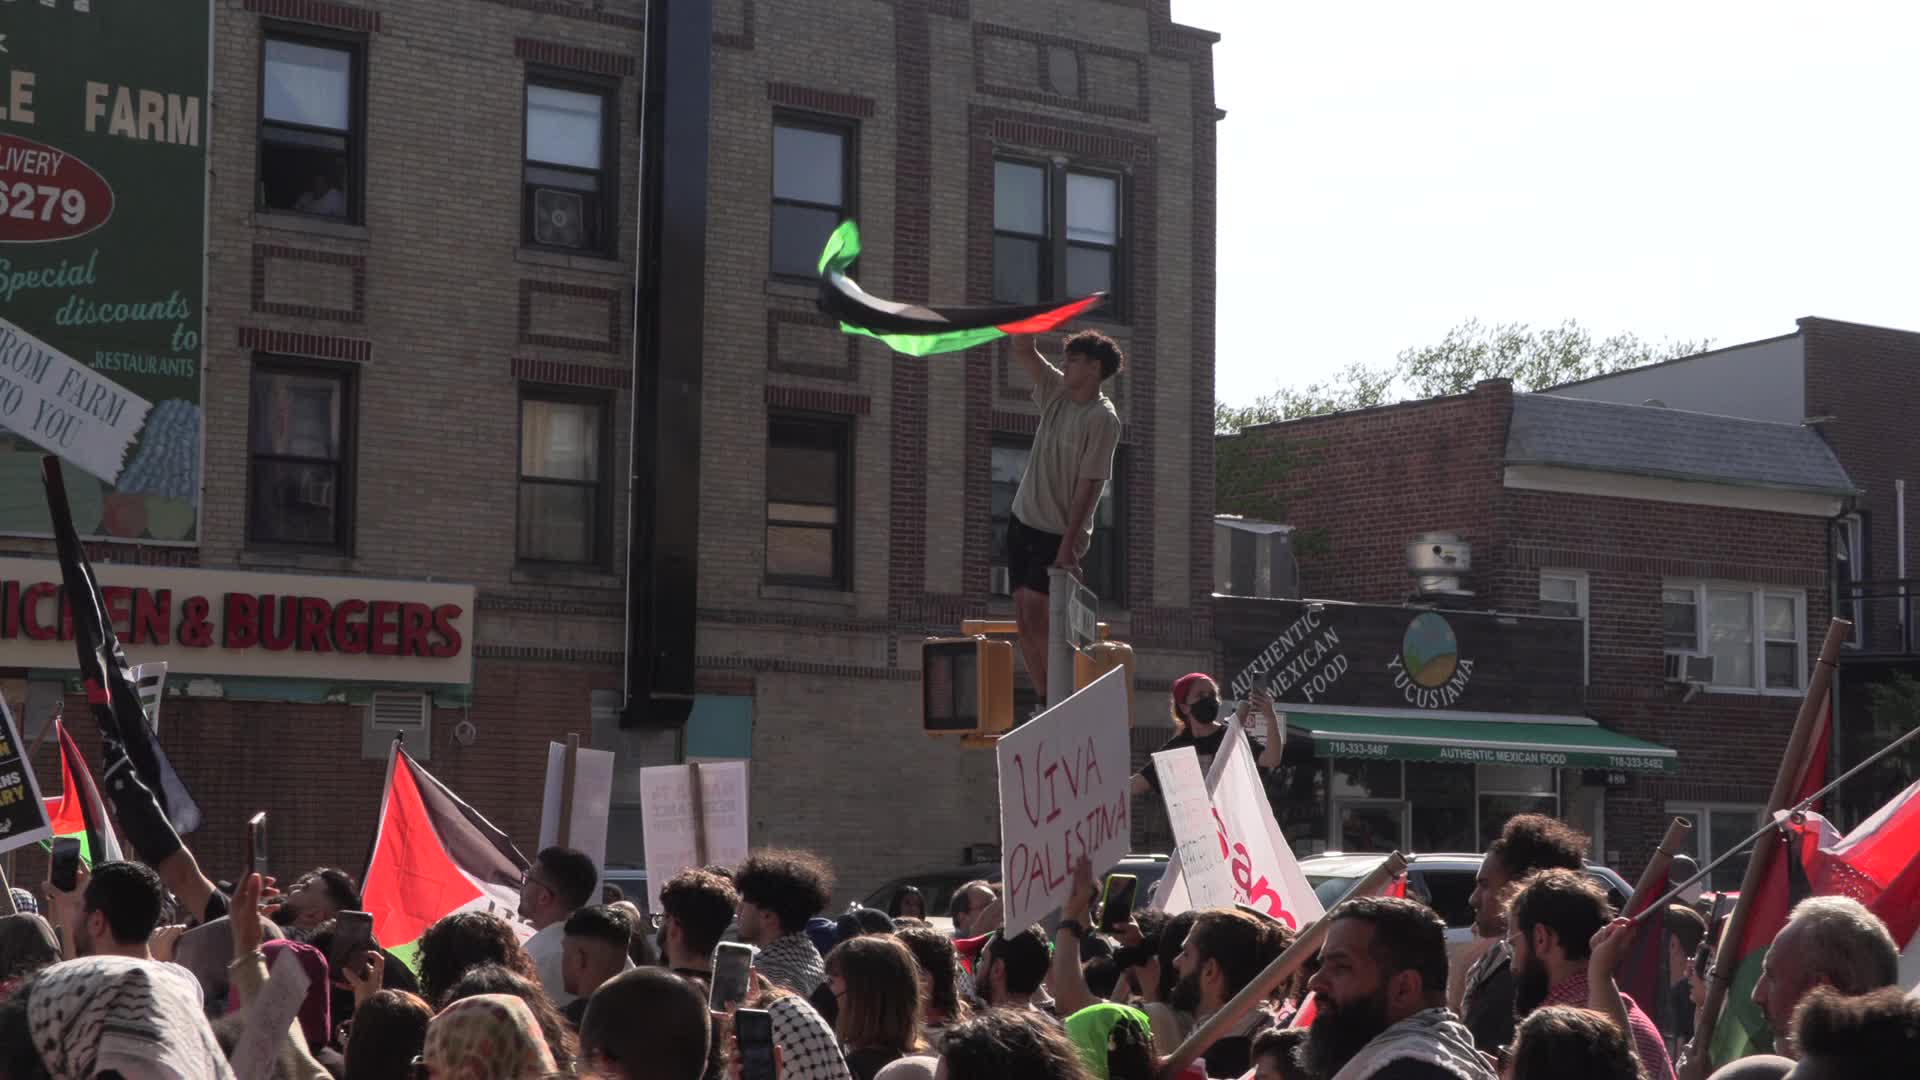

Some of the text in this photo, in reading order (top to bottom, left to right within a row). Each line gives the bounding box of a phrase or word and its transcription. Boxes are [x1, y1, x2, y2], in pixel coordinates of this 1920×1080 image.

[0, 70, 200, 147] E FARM
[56, 290, 191, 326] discounts
[172, 322, 198, 352] to
[0, 328, 127, 428] ROM FARM
[95, 351, 194, 377] RESTAURANTS
[32, 399, 83, 448] YOU
[179, 595, 214, 647] &
[223, 592, 463, 658] BURGERS
[1231, 609, 1321, 701] AUTHENTIC
[1265, 626, 1340, 699] MEXICAN
[1302, 654, 1349, 703] FOOD
[1386, 655, 1474, 708] YUCUSIAMA
[1014, 735, 1102, 829] VIVA
[1440, 747, 1567, 765] AUTHENTIC MEXICAN FOOD
[1009, 789, 1128, 918] PALESTINA
